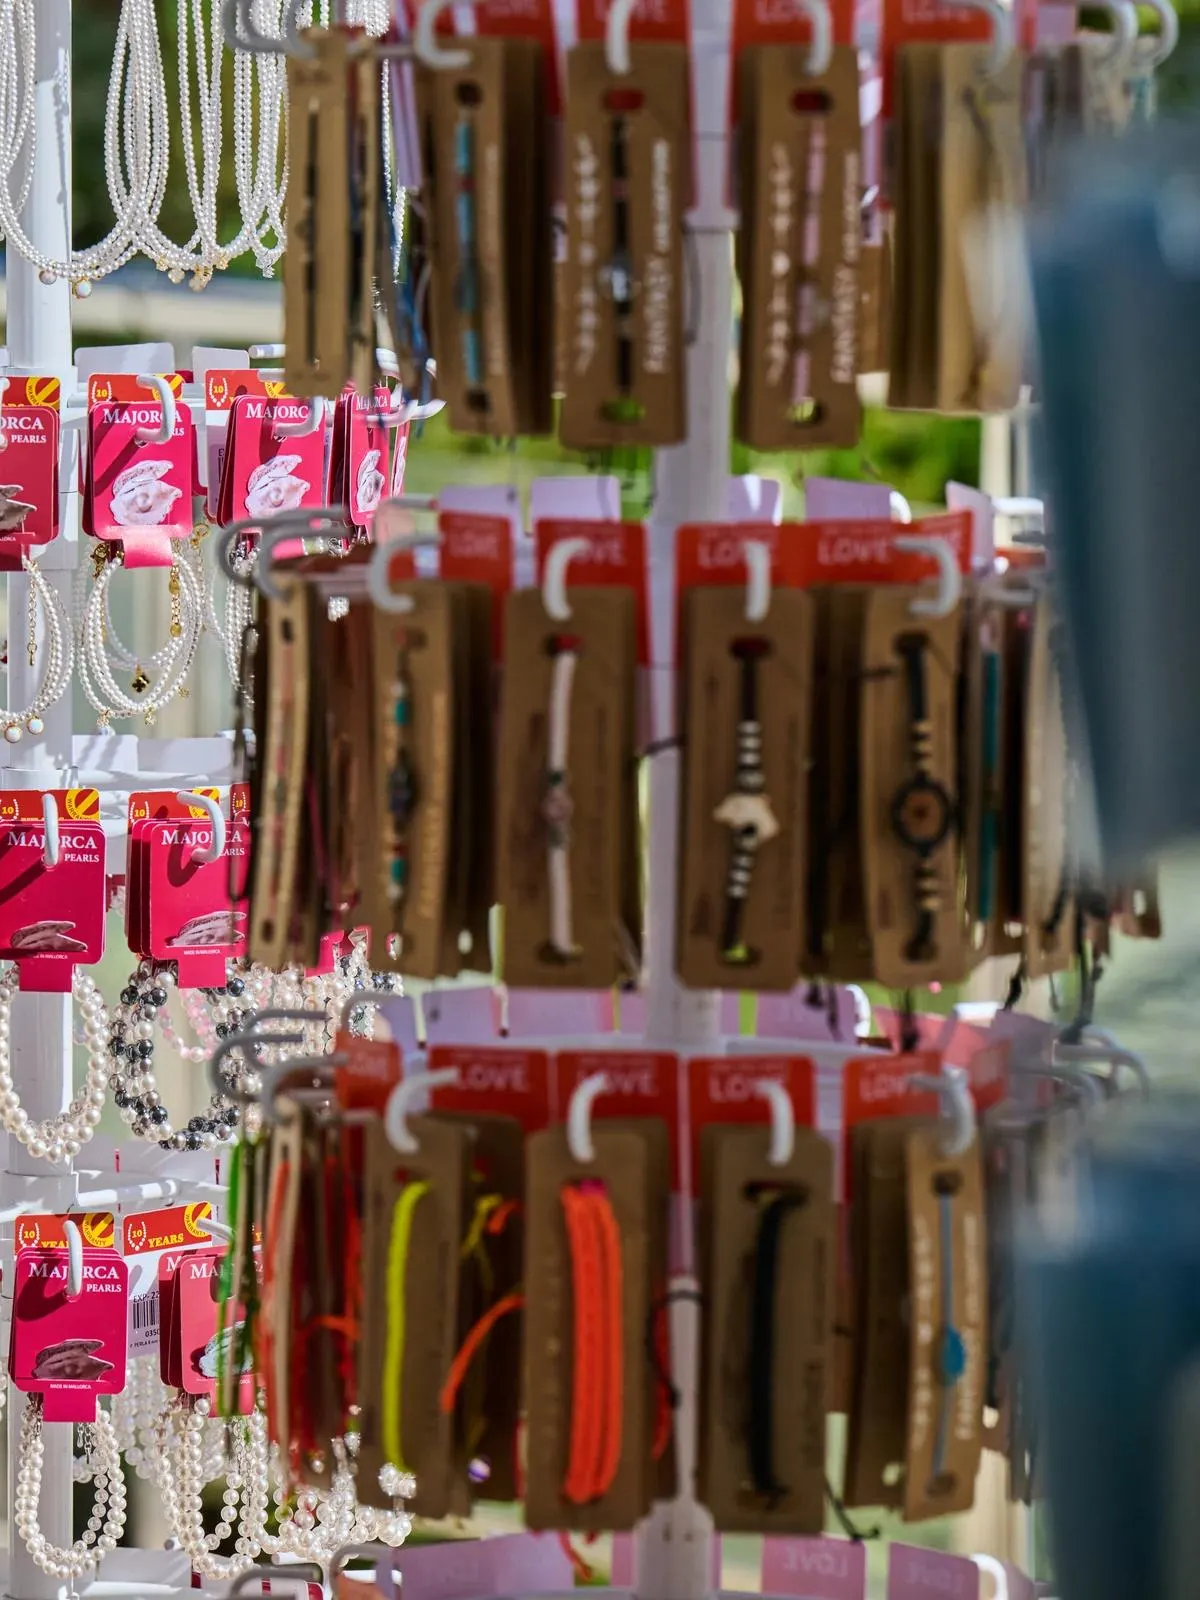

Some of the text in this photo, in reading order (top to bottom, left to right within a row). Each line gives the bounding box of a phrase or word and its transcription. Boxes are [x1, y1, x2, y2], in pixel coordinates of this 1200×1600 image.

[96, 389, 108, 397] 10
[213, 385, 224, 394] 10
[103, 408, 183, 425] MAJORA
[245, 403, 309, 420] MAJORC
[11, 434, 47, 443] PEARLS
[817, 537, 890, 565] LOVE
[2, 806, 14, 814] 10
[134, 809, 145, 817] 10
[7, 831, 98, 850] MAJRCA
[161, 829, 243, 847] MAJOCA
[64, 853, 100, 863] PEARLS
[23, 1230, 36, 1238] 10
[132, 1229, 185, 1248] 10 YEARS
[28, 1262, 119, 1280] MAJRCA
[86, 1283, 122, 1292] PEARLS
